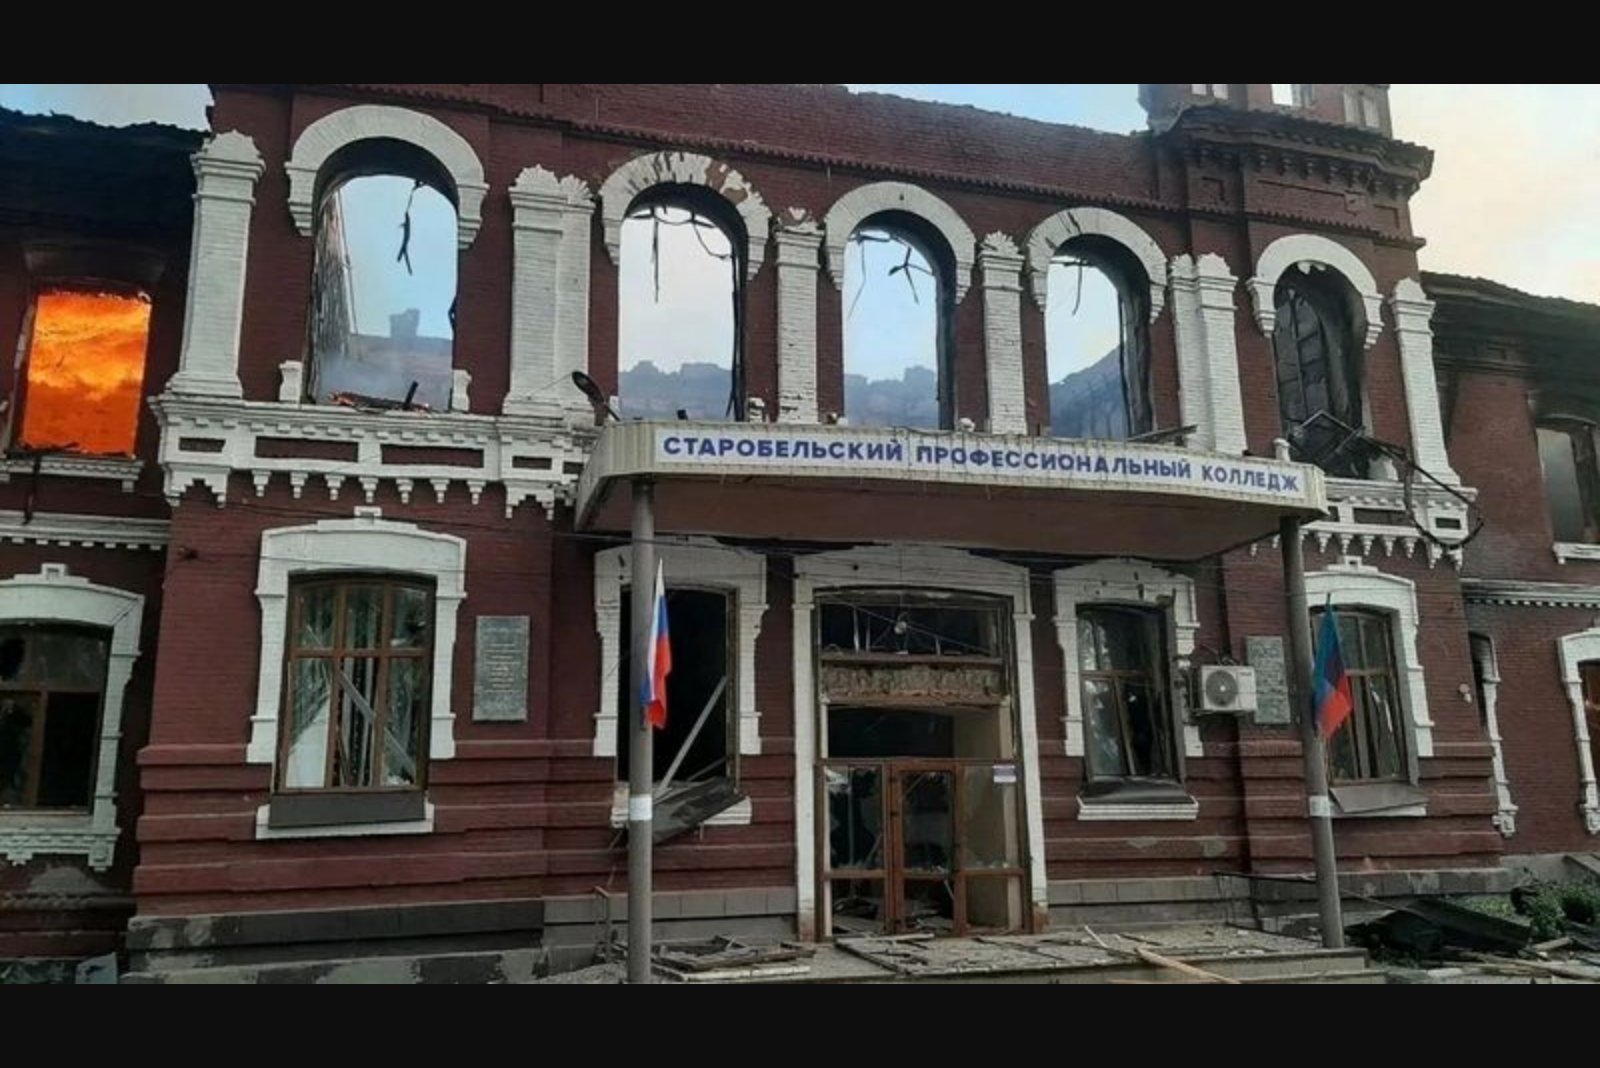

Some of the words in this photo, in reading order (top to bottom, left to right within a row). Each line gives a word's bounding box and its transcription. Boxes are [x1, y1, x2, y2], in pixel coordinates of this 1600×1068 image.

[663, 436, 903, 462] СТАРОБЕЛЬСКИЙ
[917, 444, 1192, 478] ПРОФЕССИОНАЛЬНЫЙ
[1202, 464, 1299, 492] КОЛЛЕДЖ
